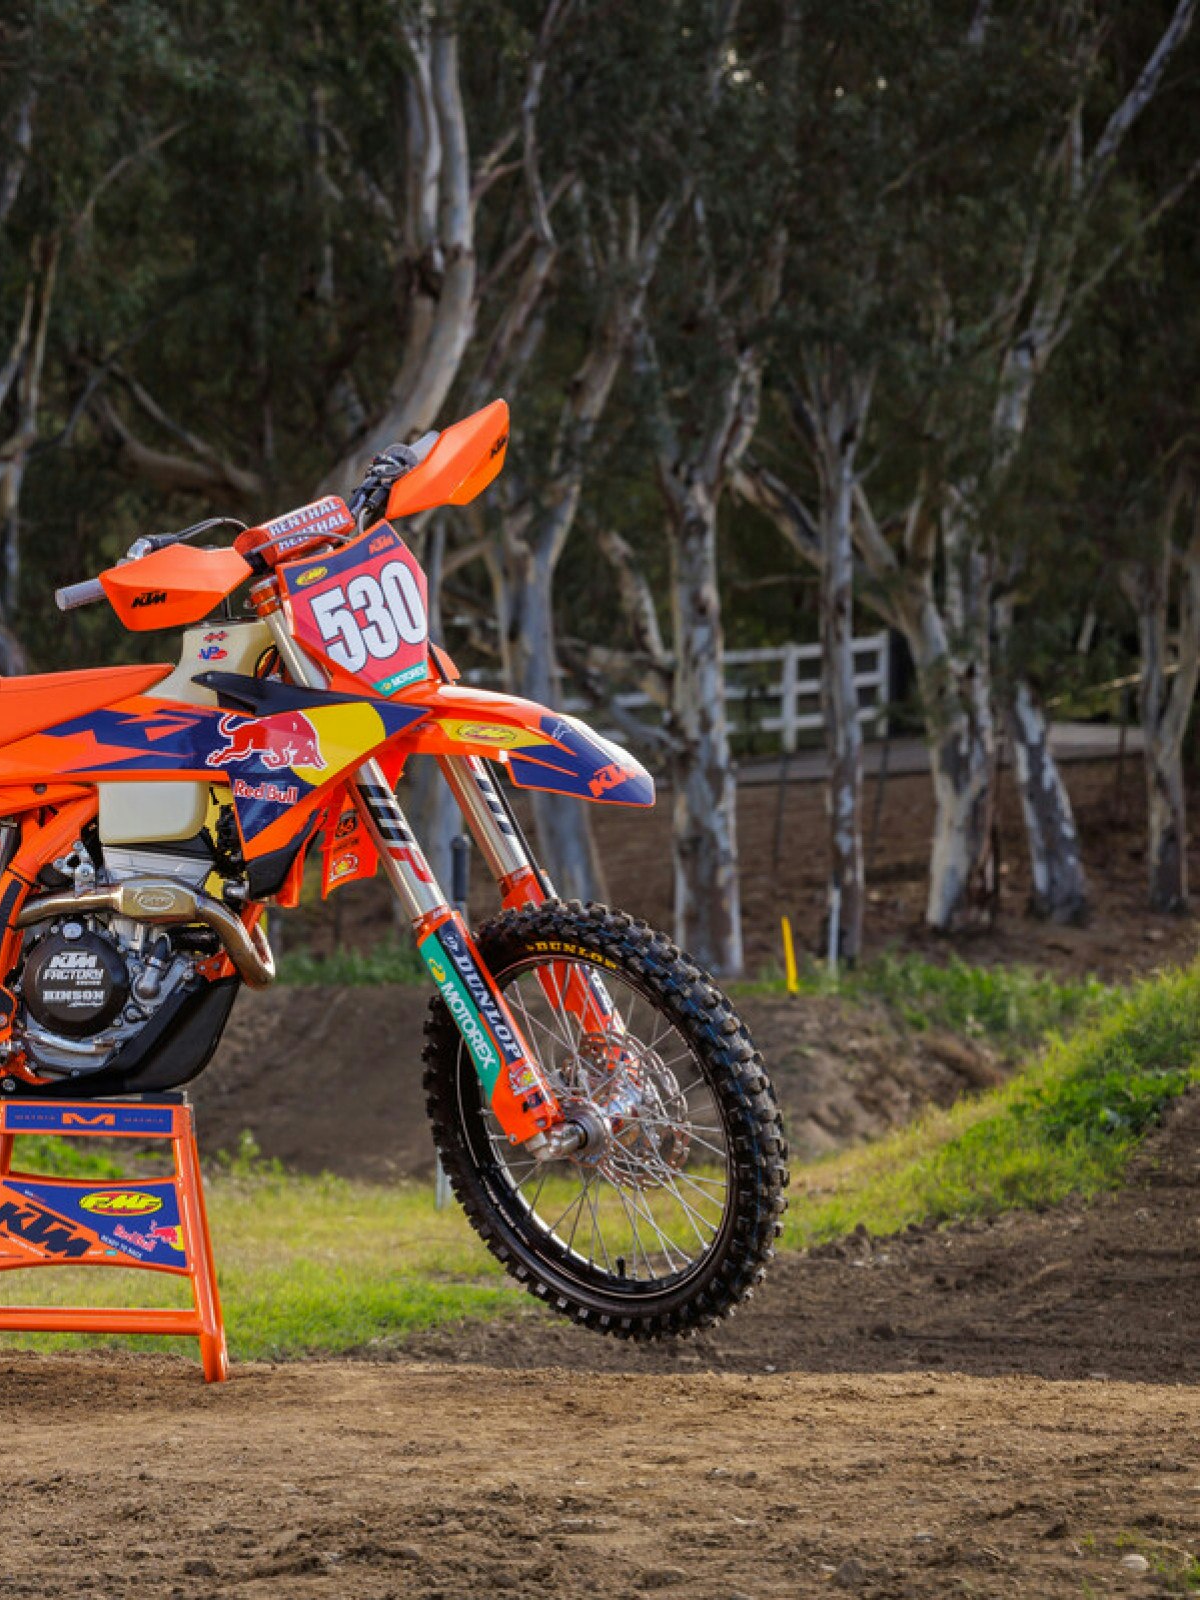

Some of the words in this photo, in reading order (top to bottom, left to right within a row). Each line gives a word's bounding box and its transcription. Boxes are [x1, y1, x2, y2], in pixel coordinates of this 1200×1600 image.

[268, 499, 341, 536] RENTHAL
[131, 591, 167, 609] KTM
[309, 560, 428, 673] 530
[233, 779, 266, 799] Red
[266, 784, 299, 804] Bull
[43, 969, 104, 980] FACTORY
[455, 955, 523, 1059] DUNLOP
[441, 982, 496, 1070] MOTOREX
[79, 1192, 163, 1211] FMF
